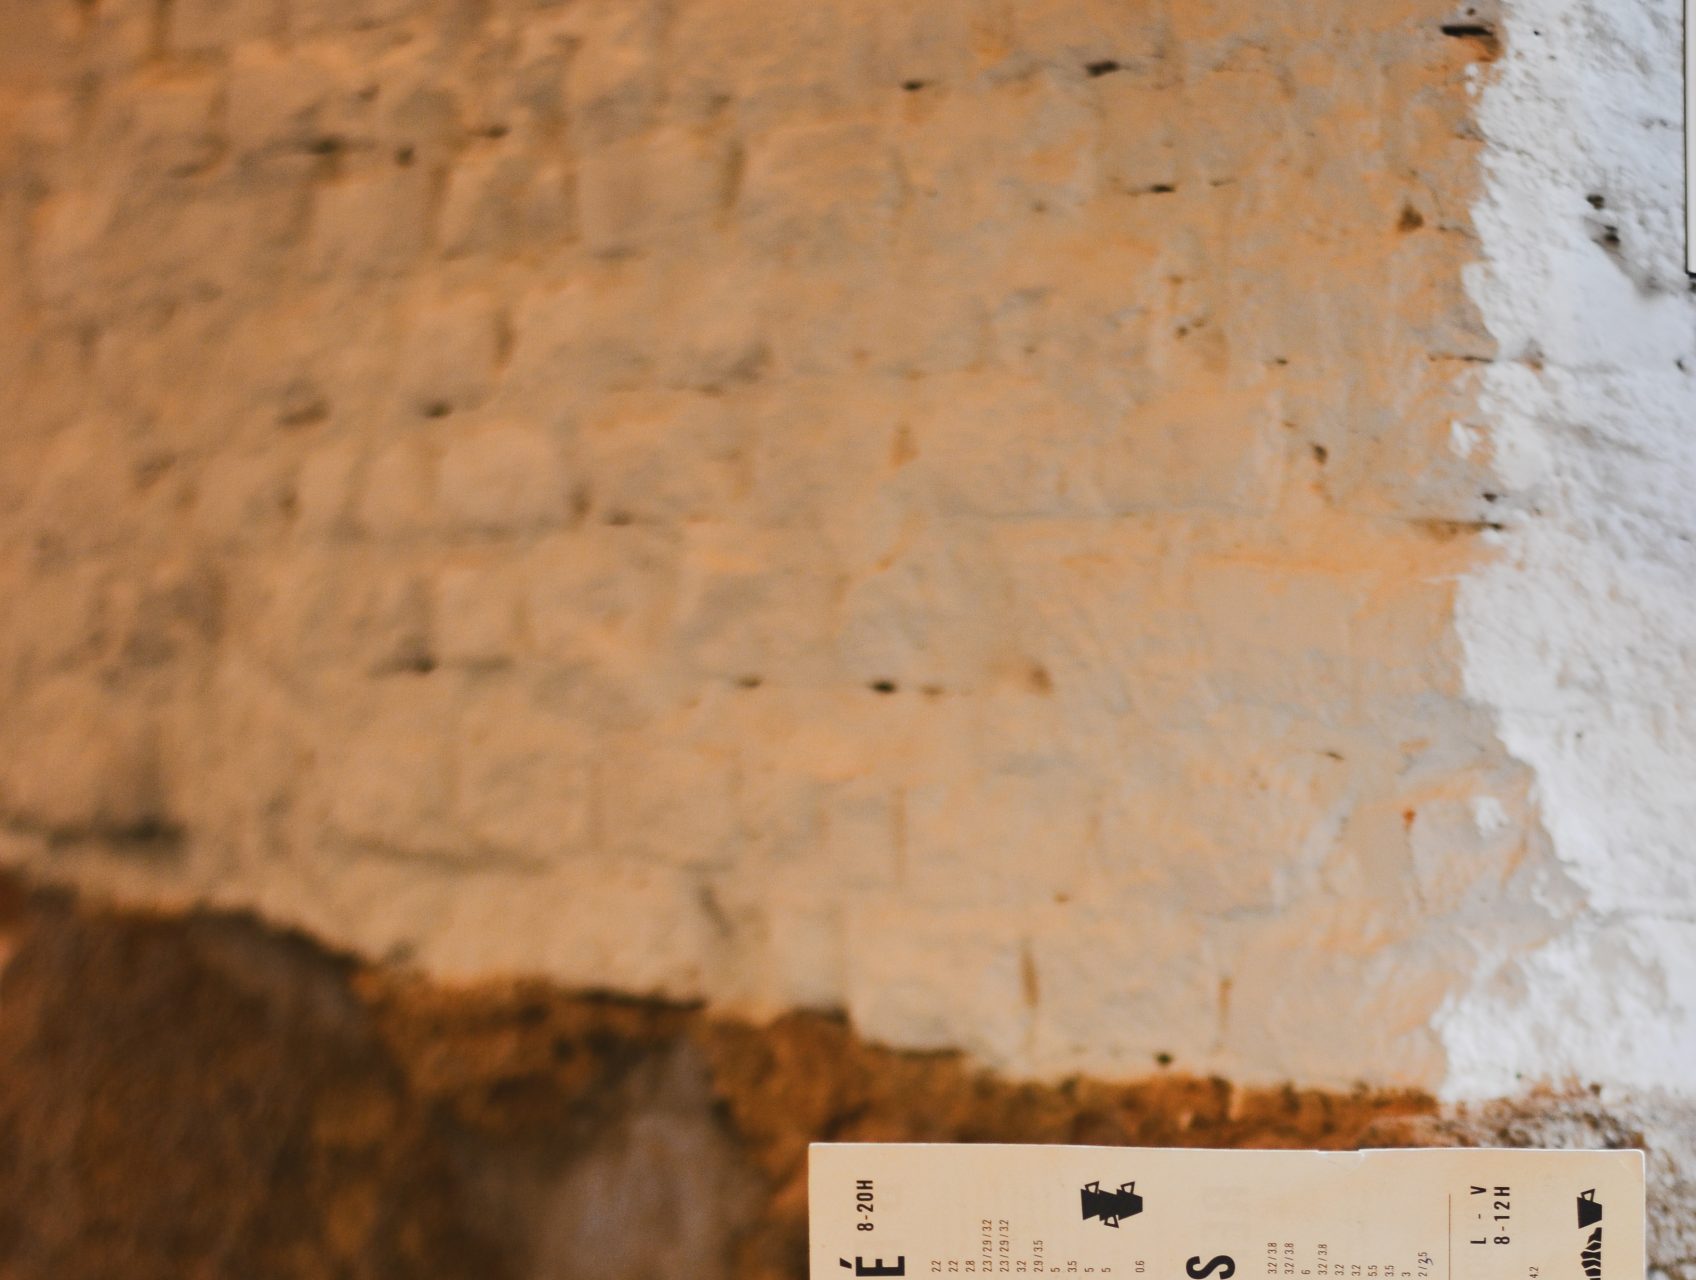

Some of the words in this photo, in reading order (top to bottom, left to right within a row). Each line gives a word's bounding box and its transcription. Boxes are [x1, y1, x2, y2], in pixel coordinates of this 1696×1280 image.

[1470, 1185, 1487, 1195] V
[981, 1219, 993, 1232] 3.2
[998, 1219, 1009, 1232] 3.2
[982, 1239, 993, 1253] 2.9
[999, 1239, 1010, 1252] 2.9
[1032, 1240, 1044, 1253] 3.5
[1470, 1237, 1487, 1245] L
[1267, 1242, 1278, 1254] 3.8
[1283, 1242, 1295, 1255] 3.8
[1317, 1243, 1328, 1256] 3.8
[931, 1260, 942, 1273] 2.2
[947, 1260, 959, 1273] 2.2
[965, 1260, 976, 1273] 2.8
[982, 1260, 993, 1273] 2.3
[999, 1260, 1010, 1273] 2.3
[1016, 1260, 1027, 1273] 3.2
[1033, 1260, 1044, 1273] 2.9
[1067, 1260, 1078, 1273] 3.5
[1135, 1260, 1145, 1273] 0.6
[1267, 1262, 1278, 1274] 3.2
[1283, 1262, 1295, 1275] 3.2
[1317, 1263, 1328, 1276] 3.2
[1334, 1264, 1345, 1276] 3.2
[1351, 1264, 1361, 1277] 3.2
[1367, 1264, 1378, 1277] 5.5
[1384, 1265, 1395, 1277] 3.5
[1529, 1266, 1539, 1279] 4.2
